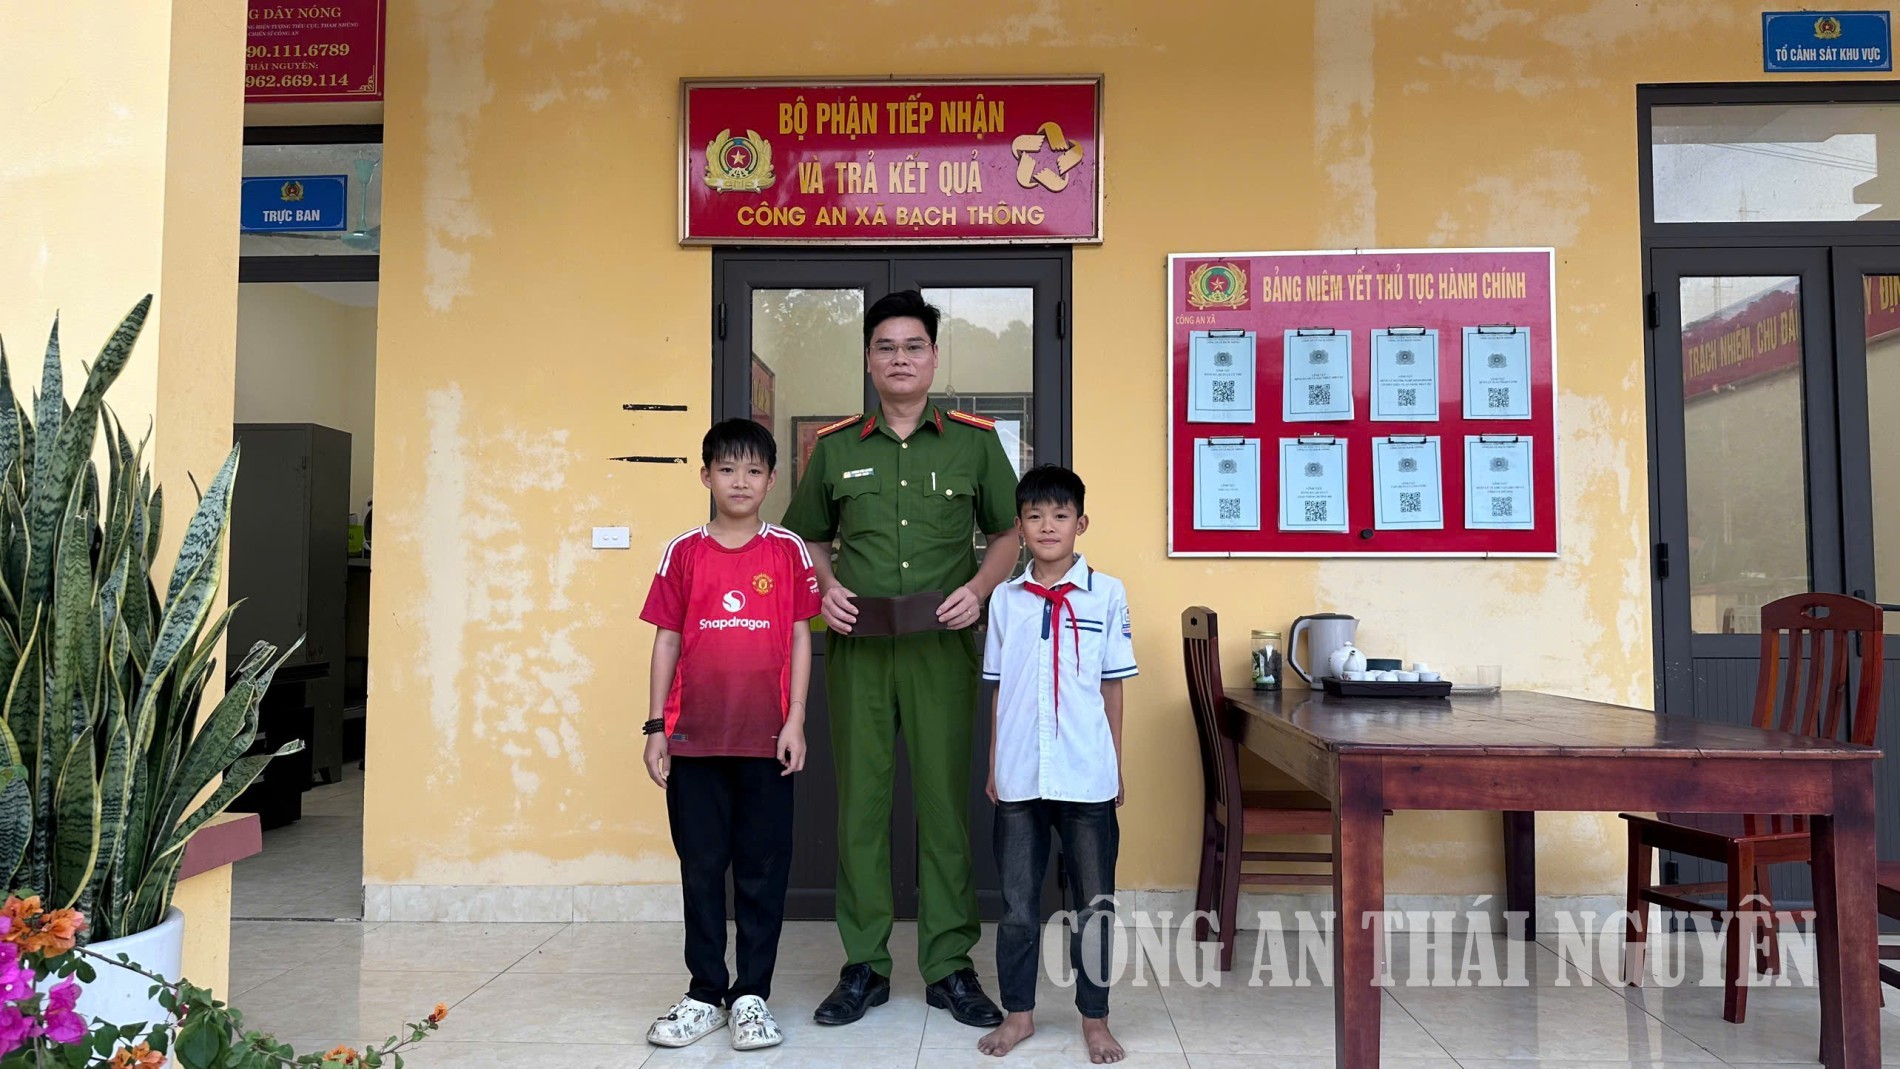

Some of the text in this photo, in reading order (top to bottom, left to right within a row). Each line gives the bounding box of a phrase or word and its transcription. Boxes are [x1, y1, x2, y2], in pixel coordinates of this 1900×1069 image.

[264, 6, 295, 19] DÂY
[297, 4, 342, 19] NÓNG
[246, 43, 350, 58] 90.111.6789
[1775, 44, 1880, 63] TỔ CẢNH SÁT KHU VỰC
[245, 73, 349, 88] 962.669.114
[779, 92, 1005, 141] BỘ PHẬN TIẾP NHẬN
[798, 148, 982, 197] VÀ TRẢ KẾT QUẢ
[263, 208, 321, 225] TRỰC BAN
[737, 200, 1046, 231] CÔNG AN XÃ BẠCH THÔNG
[1262, 265, 1302, 303] BẢNG
[1347, 265, 1373, 301] YẾT
[1376, 263, 1403, 301] THỦ
[1407, 272, 1434, 305] TỤC
[1438, 266, 1478, 300] HÀNH
[1481, 266, 1526, 299] CHÍNH
[1879, 275, 1900, 314] ĐỊN
[1175, 313, 1217, 325] CÔNG AN XÃ
[1689, 337, 1718, 378] TRÁCH
[1756, 315, 1778, 355] CHU
[699, 616, 771, 631] Snapdragon
